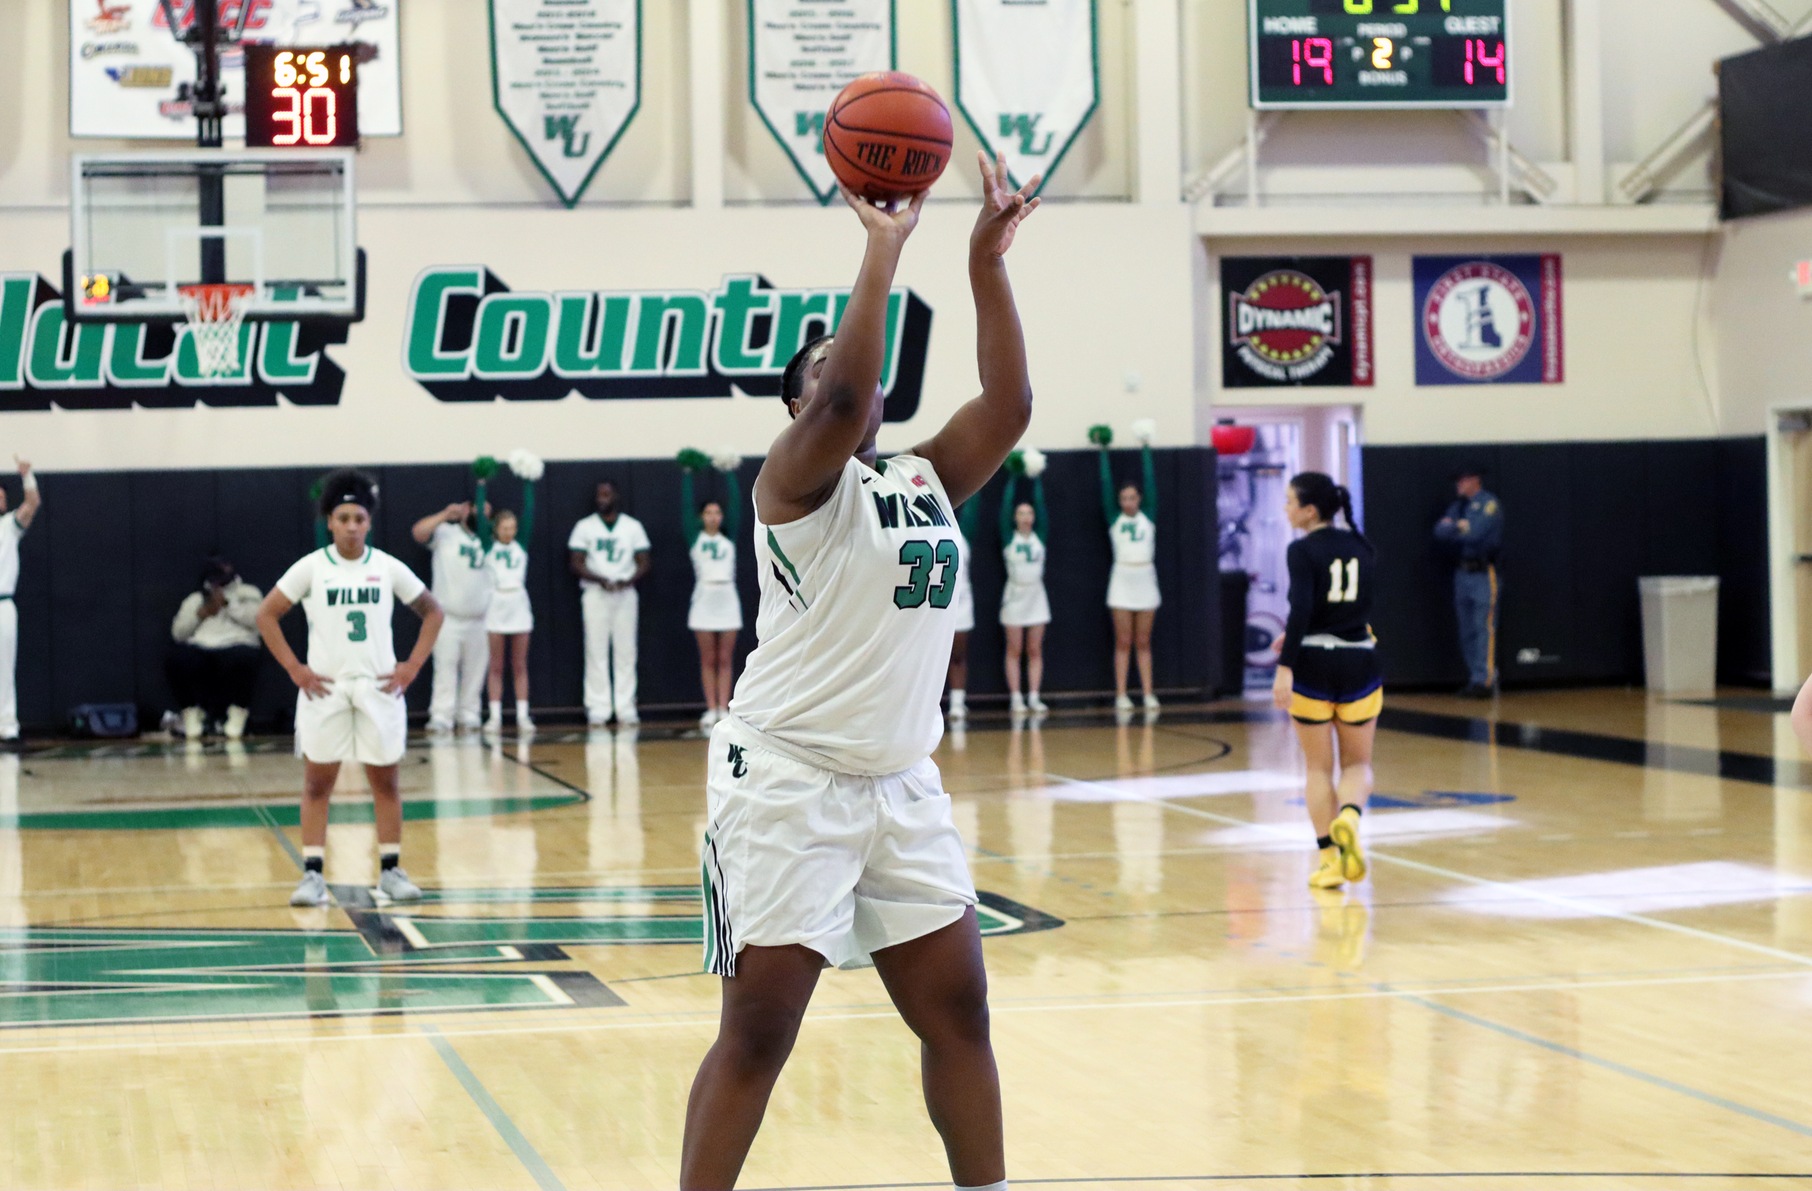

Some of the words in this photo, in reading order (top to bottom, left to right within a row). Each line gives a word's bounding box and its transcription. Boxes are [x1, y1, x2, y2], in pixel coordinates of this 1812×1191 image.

[1263, 16, 1318, 34] HOME
[1444, 15, 1500, 34] GUEST
[273, 51, 351, 87] 6:51
[1291, 37, 1334, 85] 19
[1371, 37, 1393, 69] 2
[1463, 38, 1505, 85] 14
[272, 87, 337, 145] 30
[856, 141, 897, 173] THE
[901, 141, 943, 177] ROCK
[1238, 301, 1333, 334] DYNAMIC
[893, 539, 959, 609] 33
[1327, 557, 1359, 603] 11
[326, 587, 381, 607] WILMU
[346, 610, 367, 642] 3
